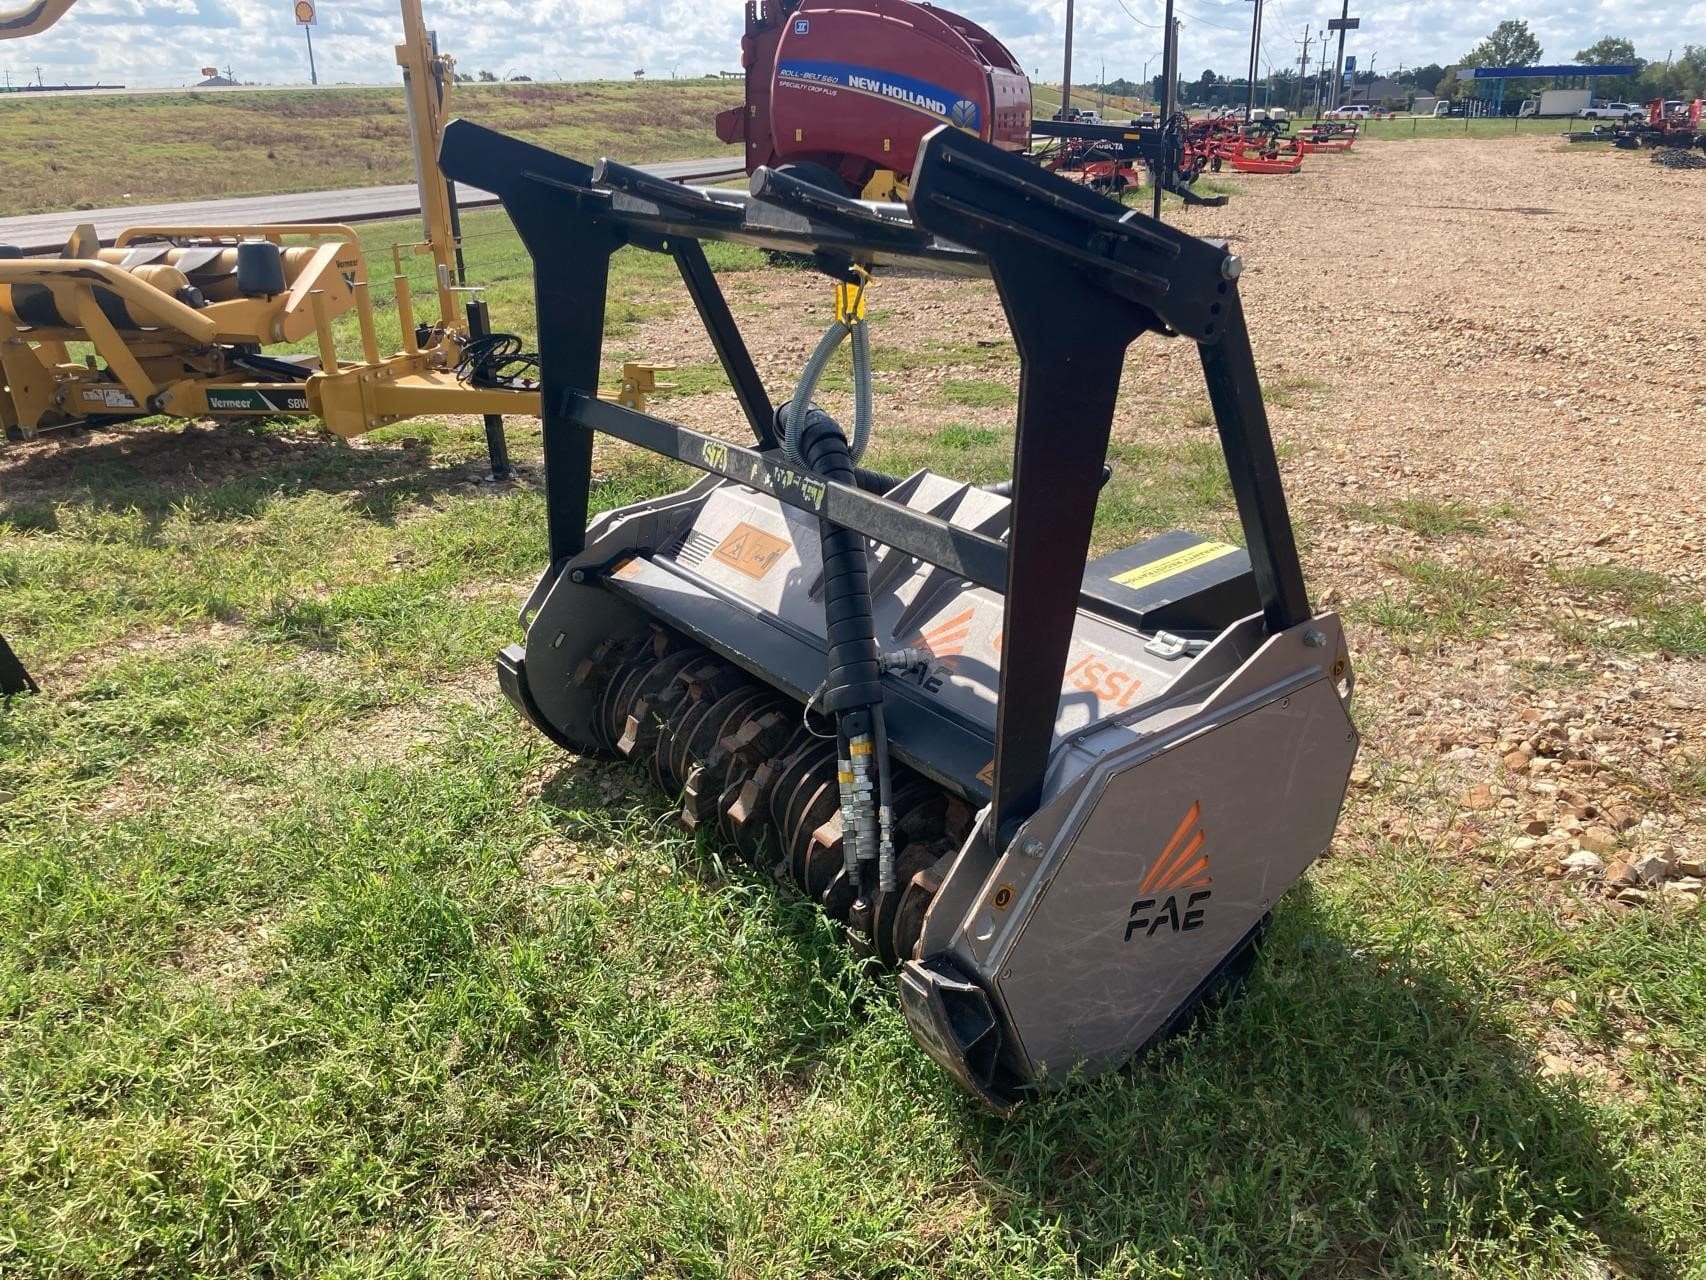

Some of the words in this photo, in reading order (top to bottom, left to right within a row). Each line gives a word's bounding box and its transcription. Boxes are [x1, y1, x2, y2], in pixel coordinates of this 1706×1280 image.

[822, 75, 839, 84] 560
[848, 74, 880, 93] NEW
[882, 83, 947, 115] HOLLAND
[210, 397, 251, 408] Vermeer
[1124, 890, 1212, 942] FAE
